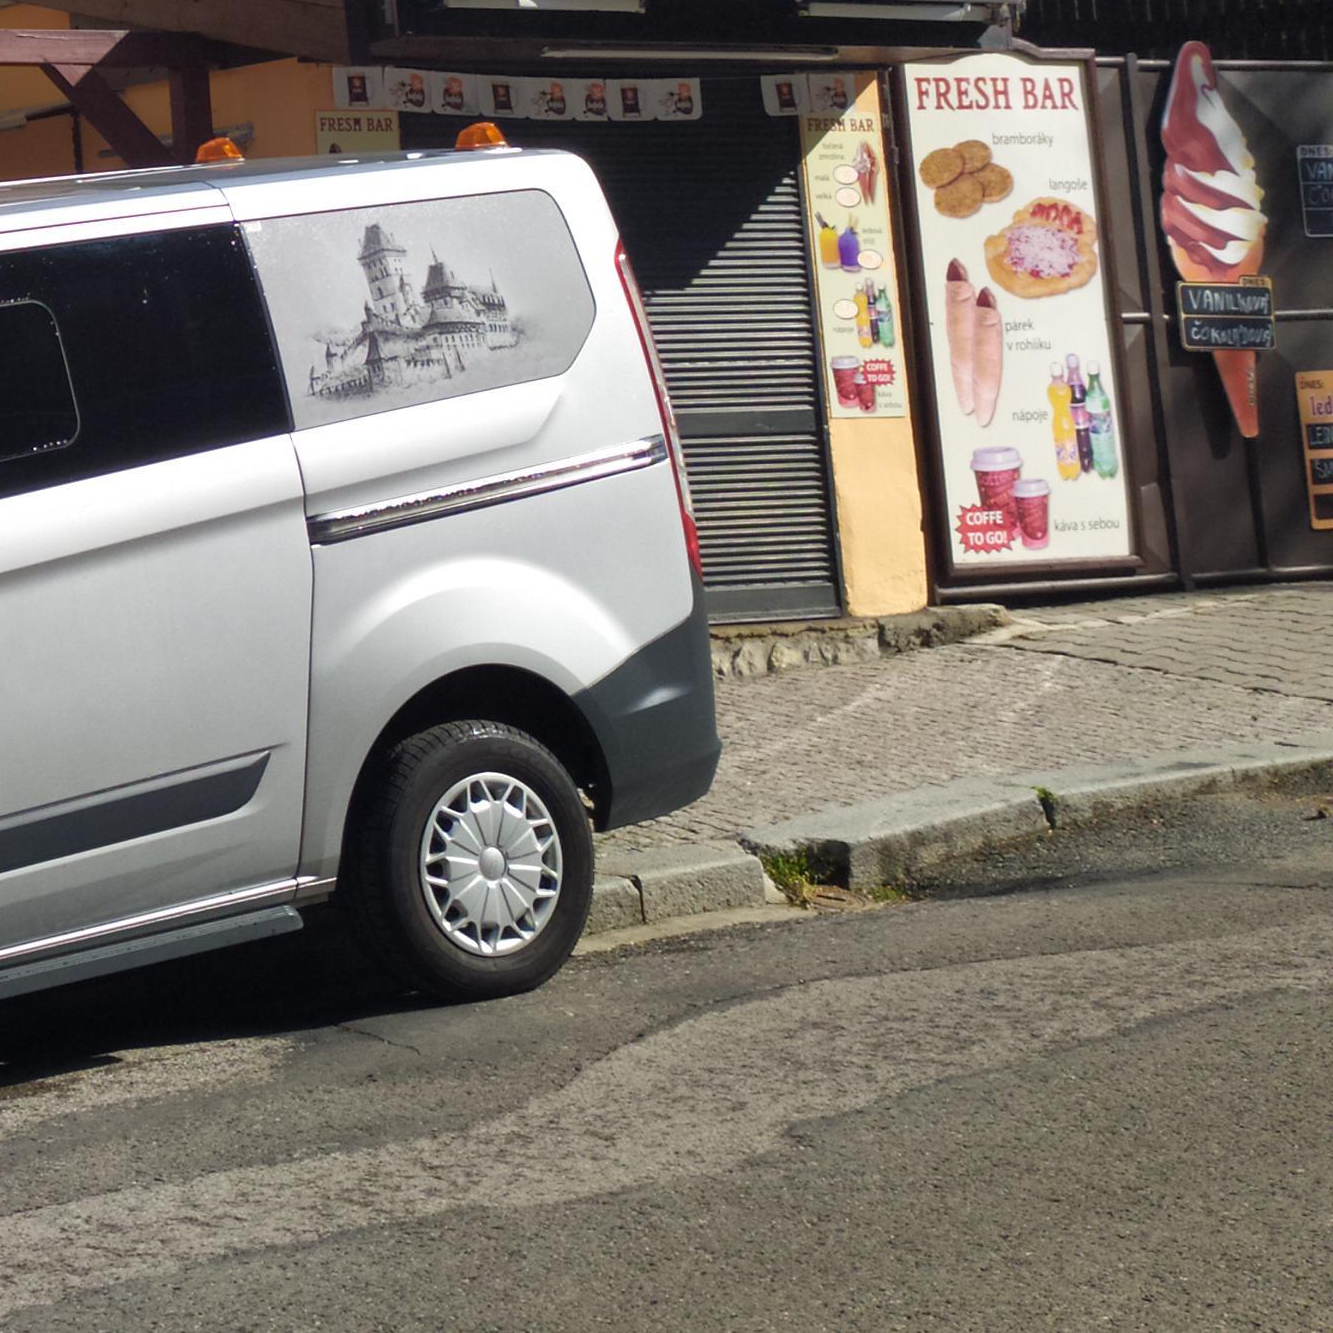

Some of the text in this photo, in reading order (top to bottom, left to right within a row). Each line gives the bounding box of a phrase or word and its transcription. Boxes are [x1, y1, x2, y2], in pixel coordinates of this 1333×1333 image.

[914, 77, 1078, 111] FRESH BAR
[320, 118, 393, 132] FRESH BAR
[807, 118, 874, 132] FRESH BAR
[992, 133, 1053, 147] bramboráky
[1049, 179, 1088, 193] langoše
[1005, 320, 1034, 333] párek
[1012, 410, 1048, 423] nápoje
[966, 511, 1004, 526] COFFE
[1055, 518, 1080, 532] káva
[1088, 517, 1120, 530] sebou
[967, 531, 1008, 545] TO GO!
